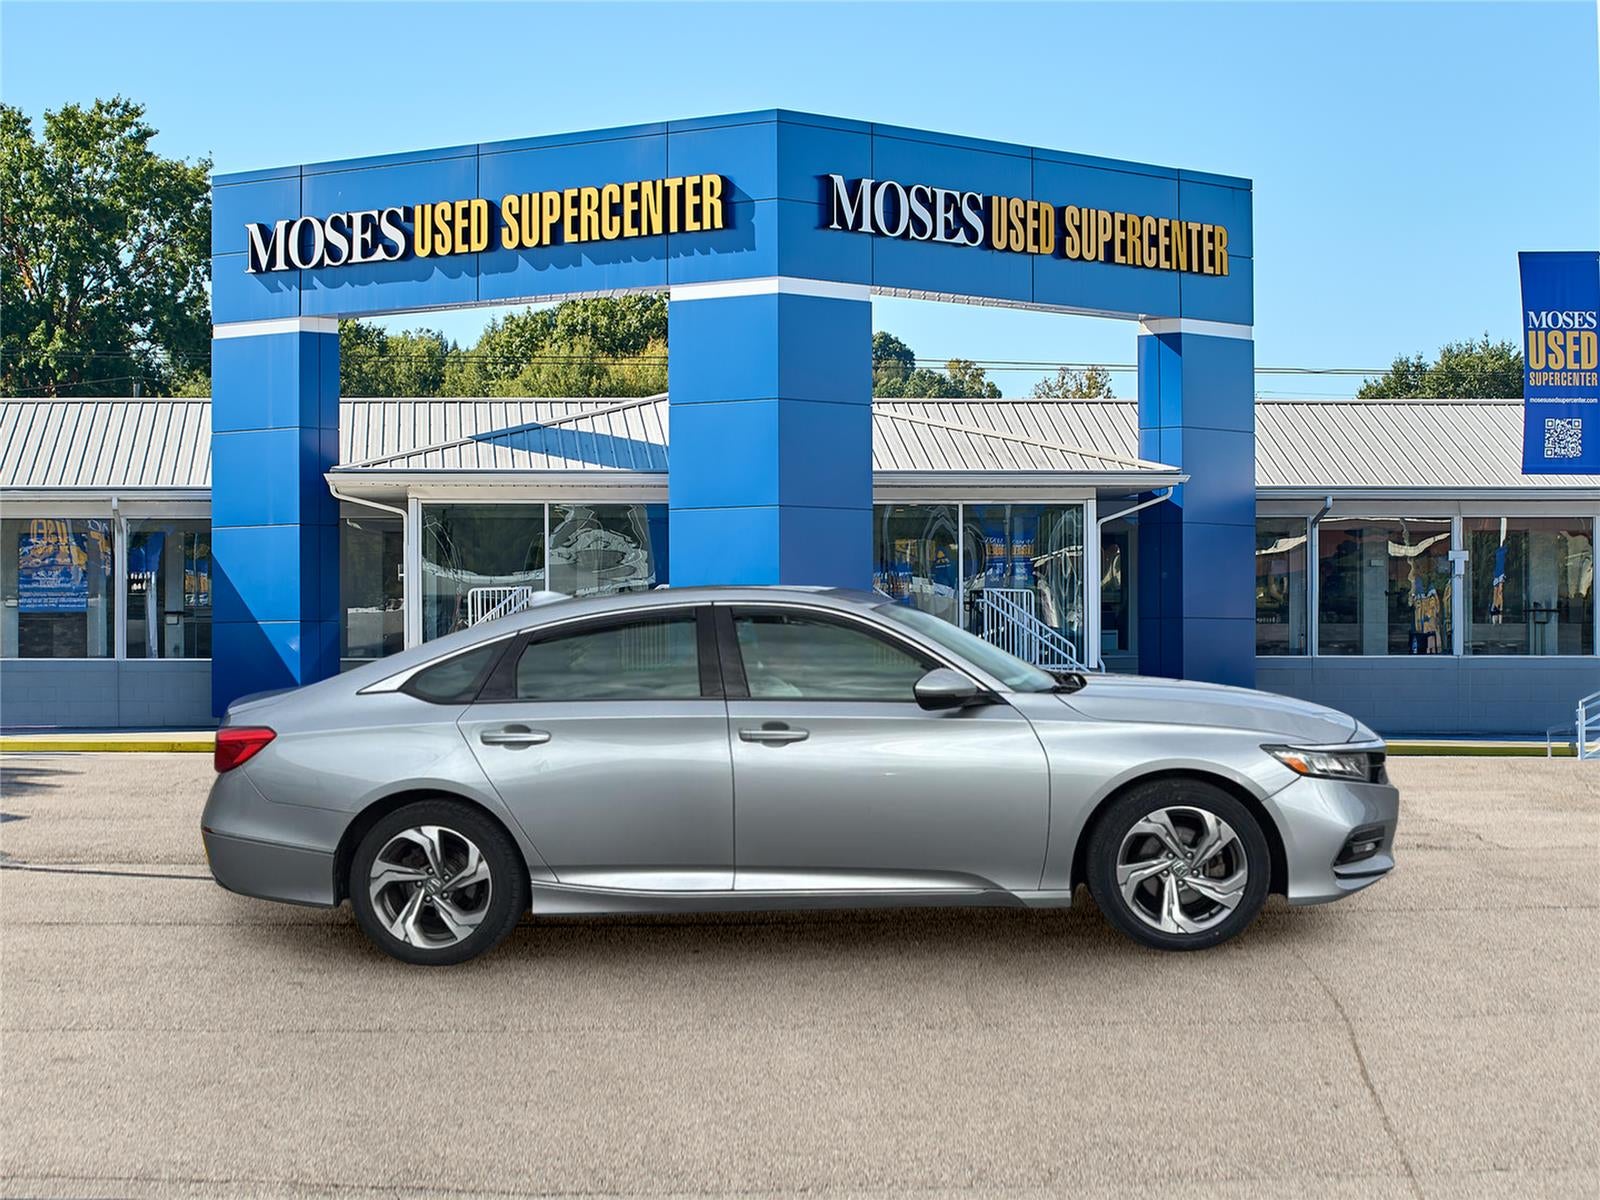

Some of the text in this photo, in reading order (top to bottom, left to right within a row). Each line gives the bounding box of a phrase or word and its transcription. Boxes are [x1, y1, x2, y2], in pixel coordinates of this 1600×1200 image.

[246, 174, 724, 273] MOSES USED SUPERCENTER
[829, 174, 1229, 276] MOSES USED SUPERCENTER
[1528, 311, 1597, 329] MOSES
[1529, 331, 1598, 370] USED
[1529, 372, 1598, 386] SUPERCENTER
